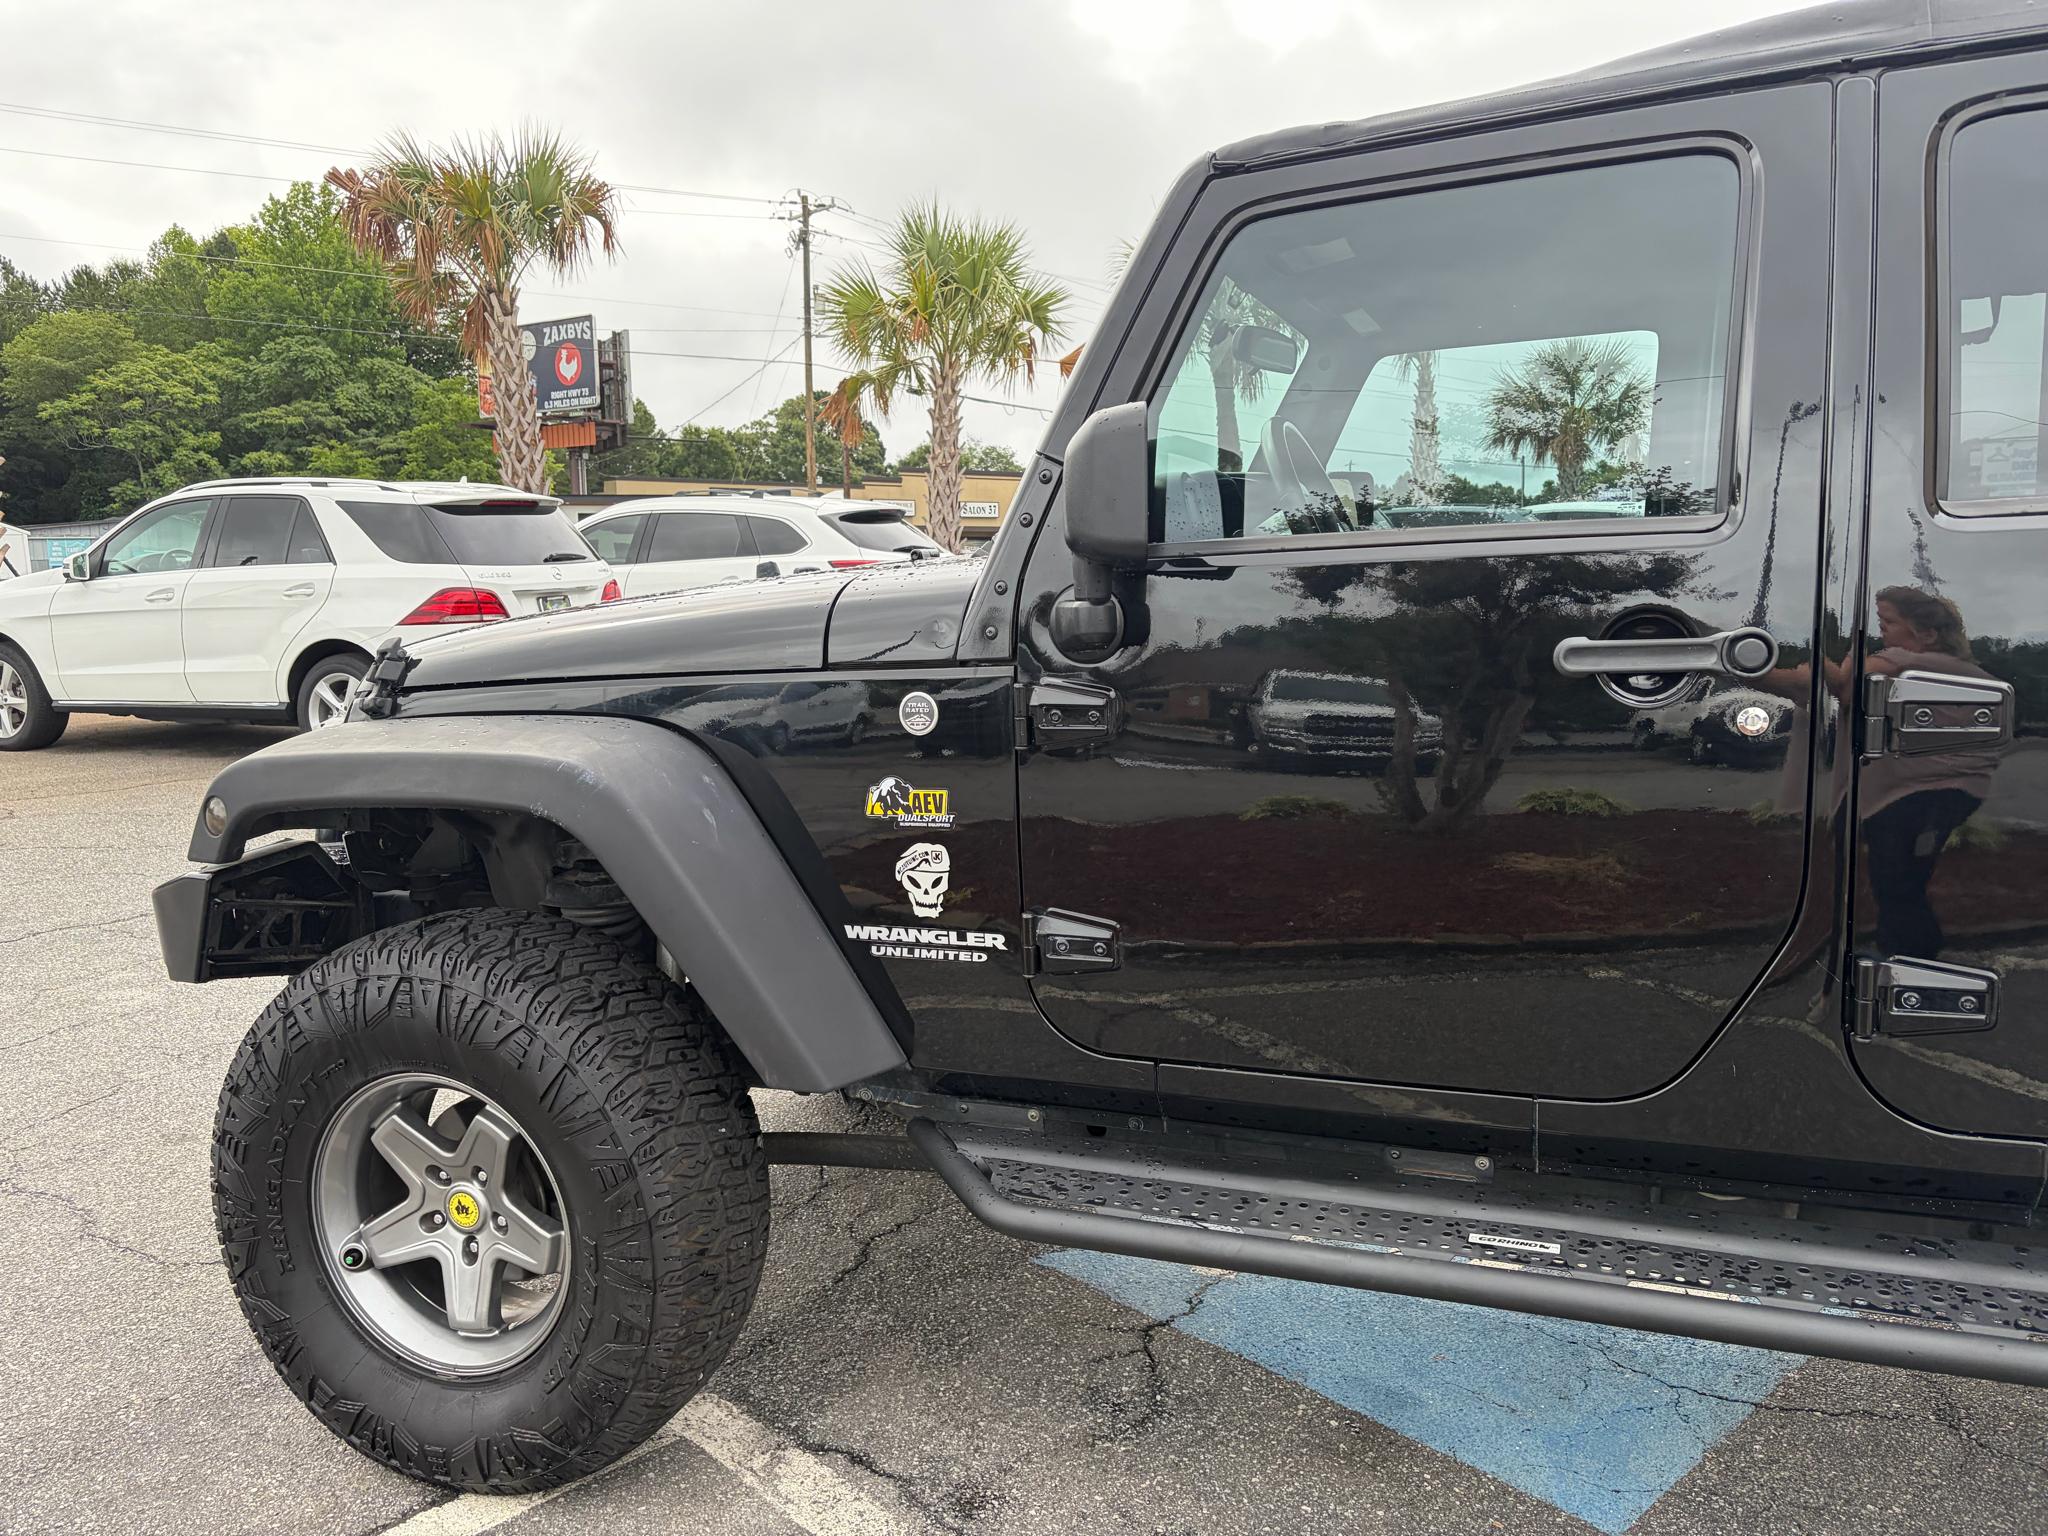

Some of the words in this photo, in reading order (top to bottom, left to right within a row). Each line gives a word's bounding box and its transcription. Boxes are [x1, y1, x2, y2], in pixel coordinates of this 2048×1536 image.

[543, 321, 592, 347] ZAXBYS
[551, 390, 567, 400] RIGHT
[568, 388, 581, 398] HWY
[554, 399, 570, 408] MILES
[571, 397, 579, 407] ON
[580, 395, 596, 405] RIGHT
[911, 793, 944, 813] AEV
[897, 814, 955, 822] DUALSPORT
[933, 852, 941, 861] JK
[844, 925, 1008, 950] WRANGLER
[871, 945, 988, 963] UNLIMITED
[265, 1119, 296, 1276] RENEGADE
[1498, 1238, 1538, 1248] RHINO
